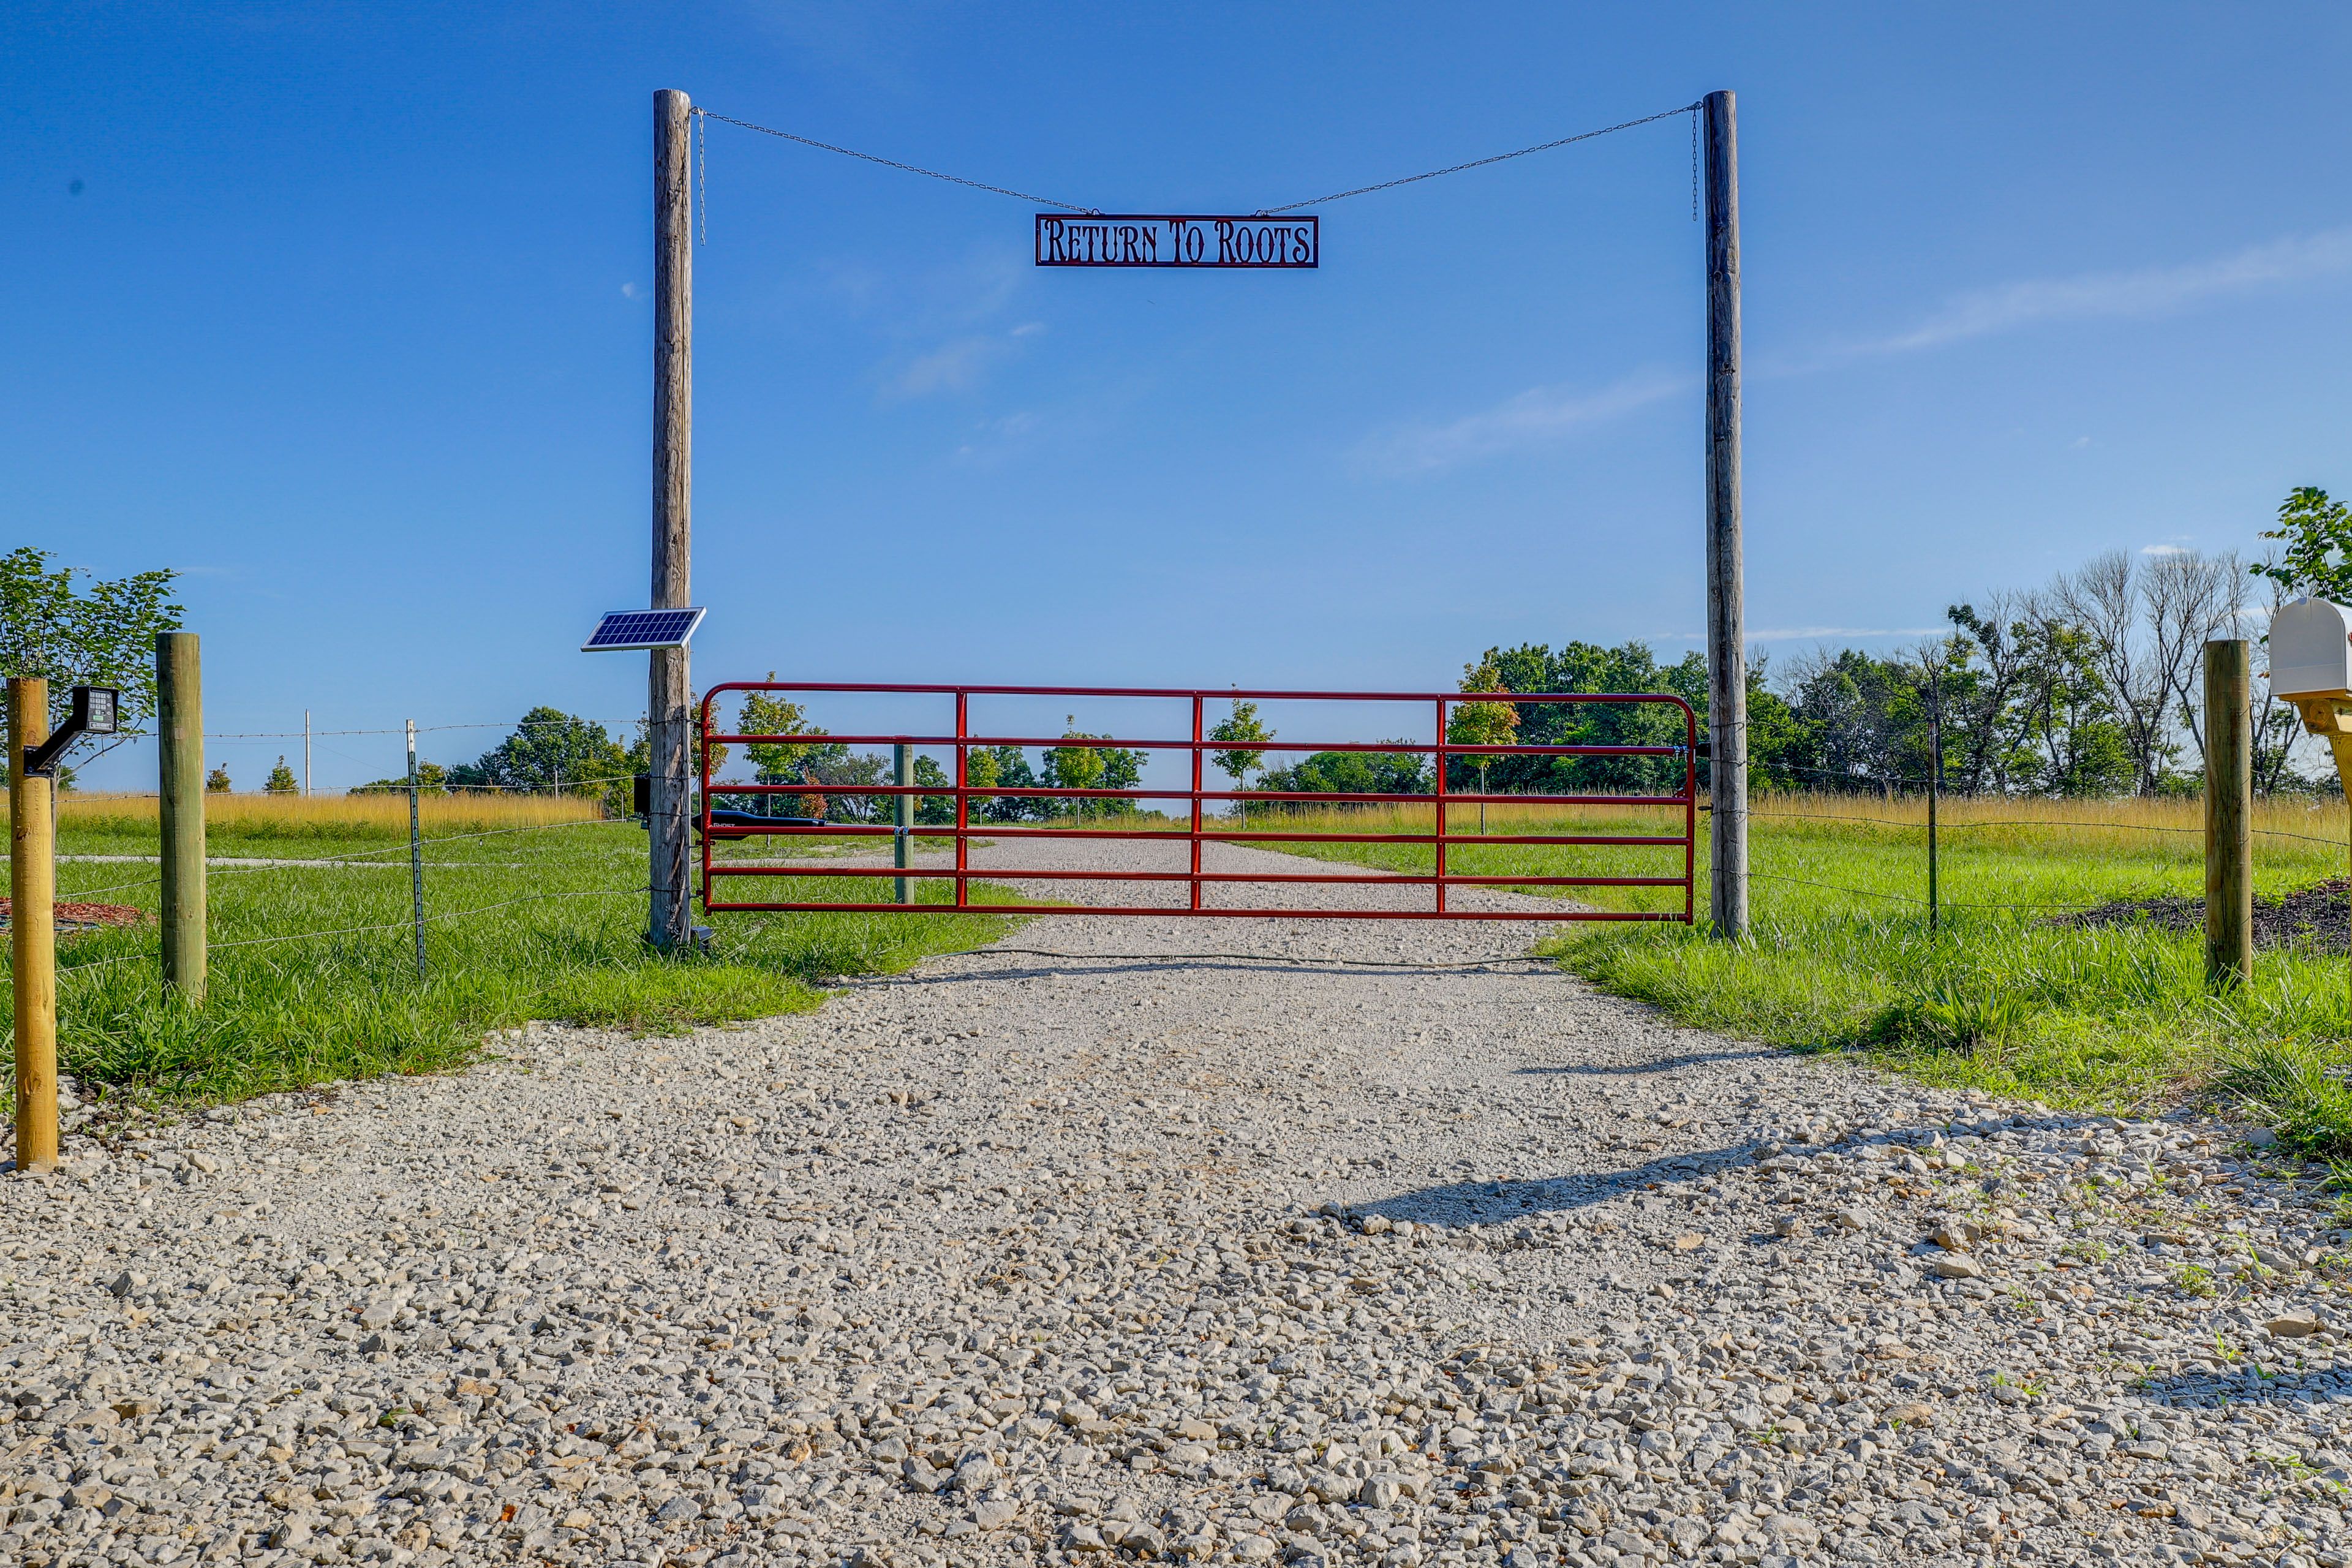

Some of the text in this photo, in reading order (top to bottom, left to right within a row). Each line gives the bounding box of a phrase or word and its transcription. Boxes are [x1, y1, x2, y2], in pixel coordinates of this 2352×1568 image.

[1044, 218, 1310, 263] RETURN TO ROOTS
